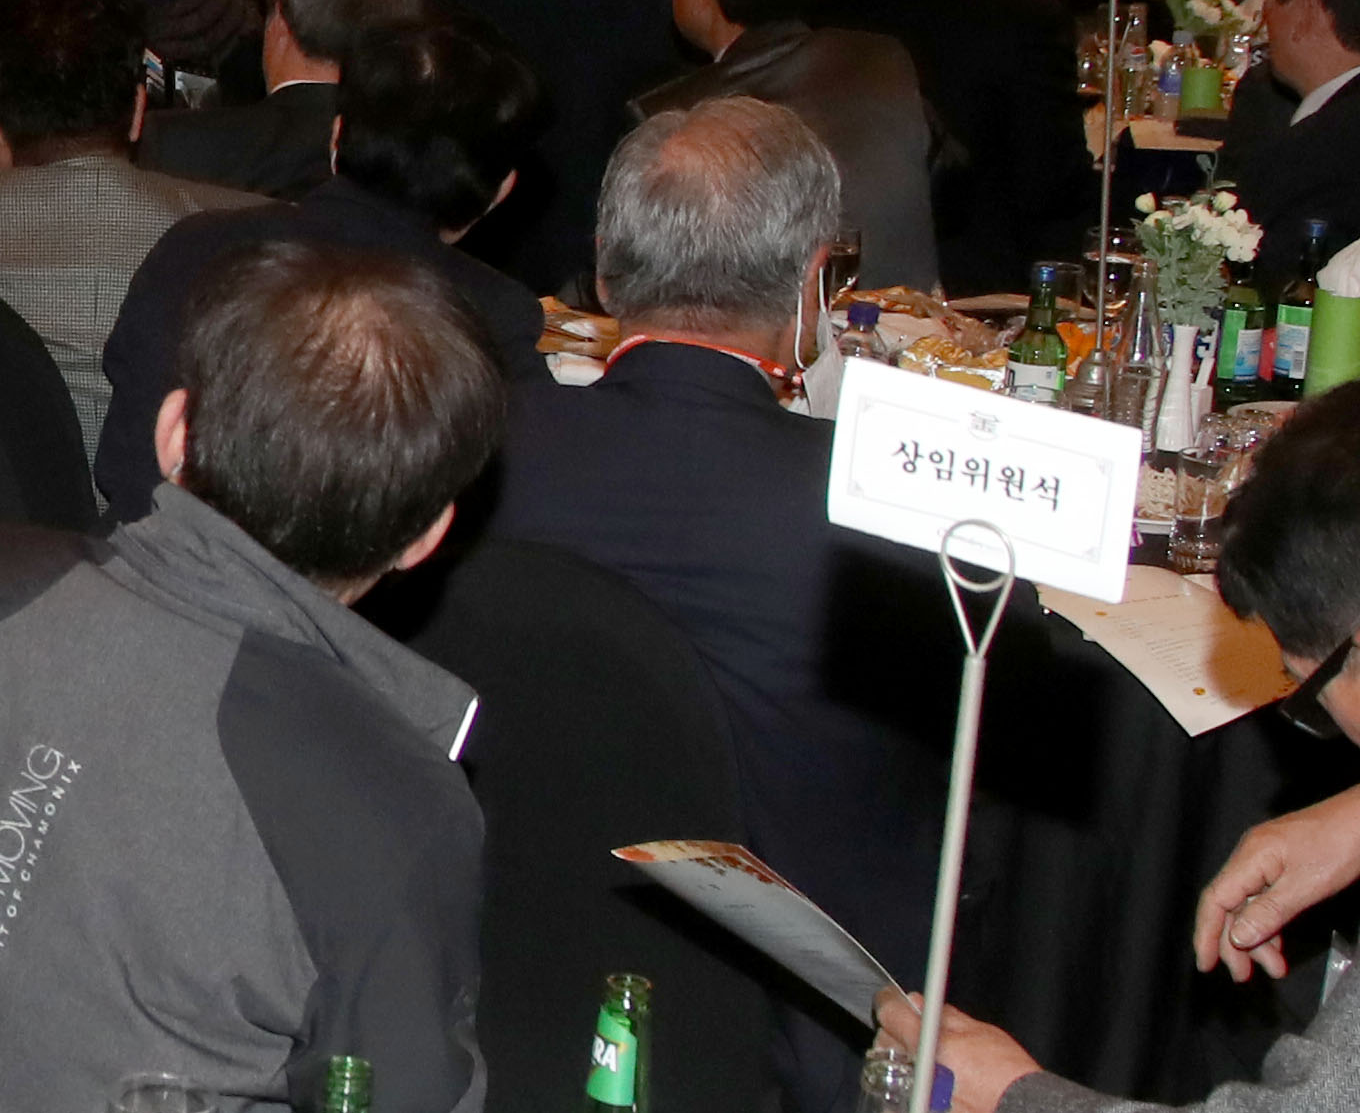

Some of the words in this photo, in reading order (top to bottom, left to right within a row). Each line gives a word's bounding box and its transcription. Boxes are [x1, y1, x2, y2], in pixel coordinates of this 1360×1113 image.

[891, 439, 1062, 513] 상임위원석
[6, 889, 23, 918] OF
[20, 759, 82, 882] CHAMONIX
